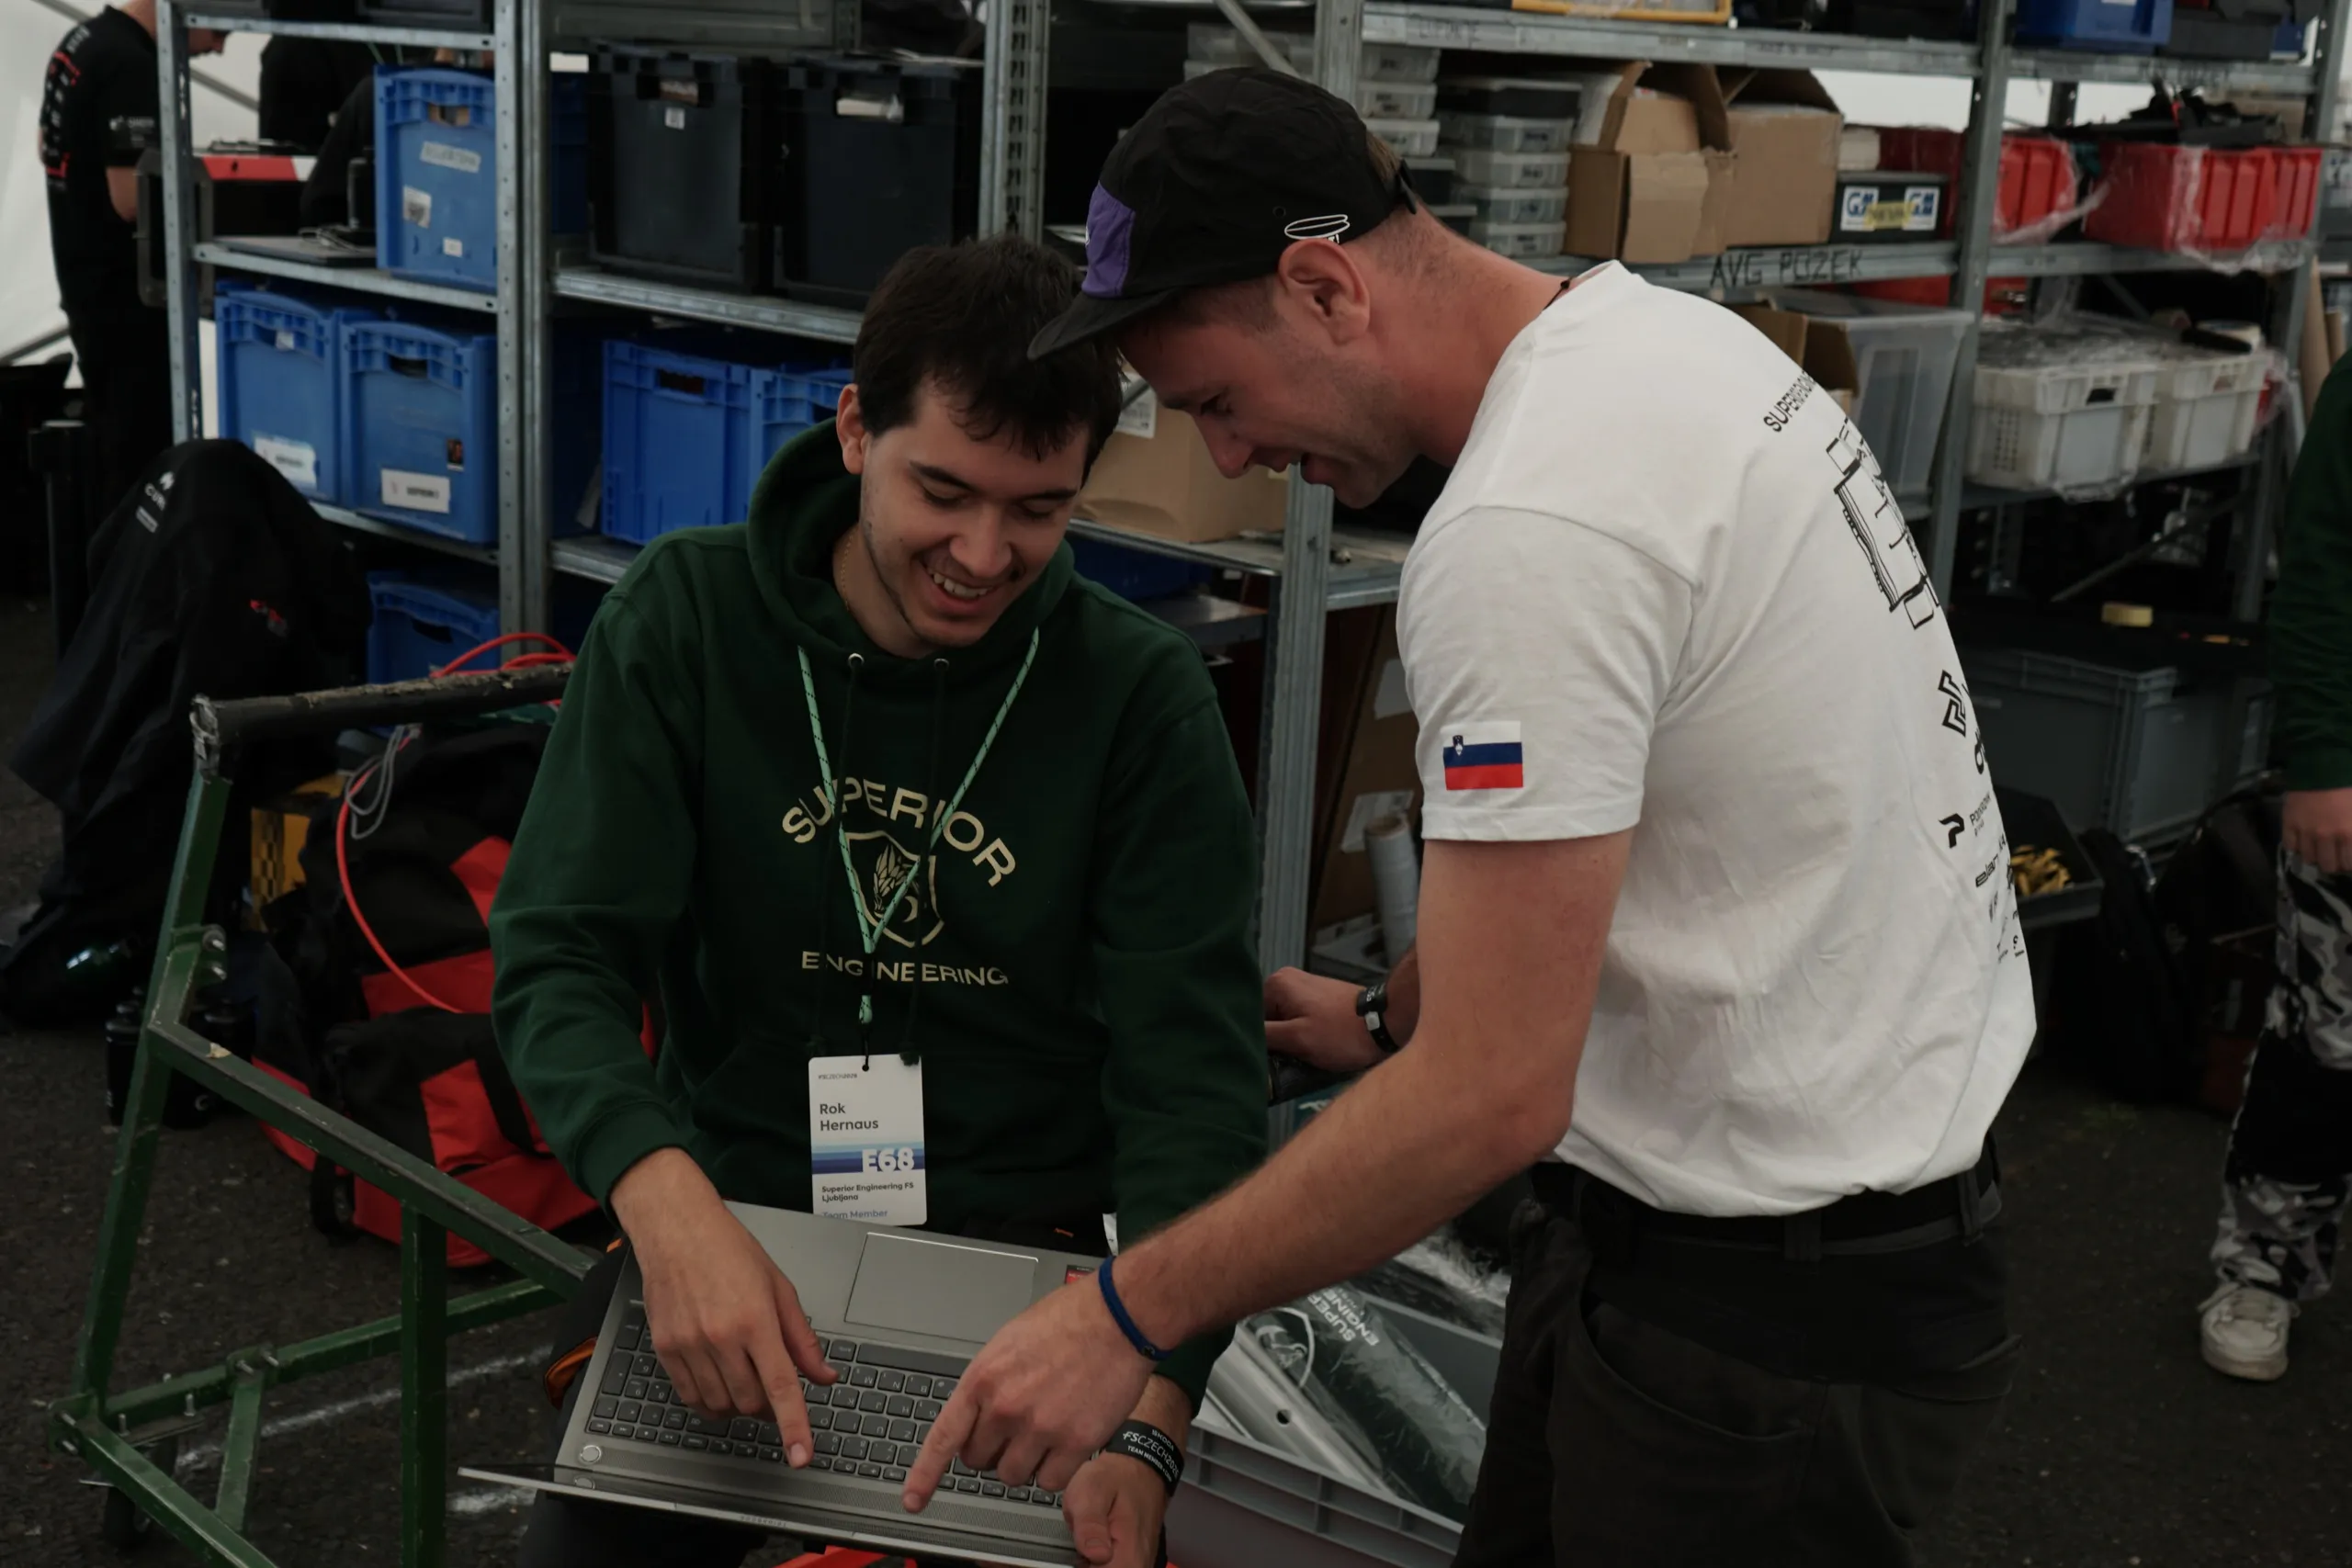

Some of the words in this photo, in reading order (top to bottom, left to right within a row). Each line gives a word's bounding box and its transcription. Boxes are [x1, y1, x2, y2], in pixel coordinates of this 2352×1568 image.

[801, 951, 1009, 987] ENGNEERING
[820, 1103, 846, 1115] Rok
[820, 1120, 879, 1132] Hernaus
[862, 1147, 915, 1173] E68
[821, 1185, 854, 1194] Superior
[856, 1182, 903, 1192] Engineering
[821, 1194, 859, 1203] Ljubljana
[850, 1210, 888, 1219] Member
[1127, 1445, 1144, 1456] TEAM
